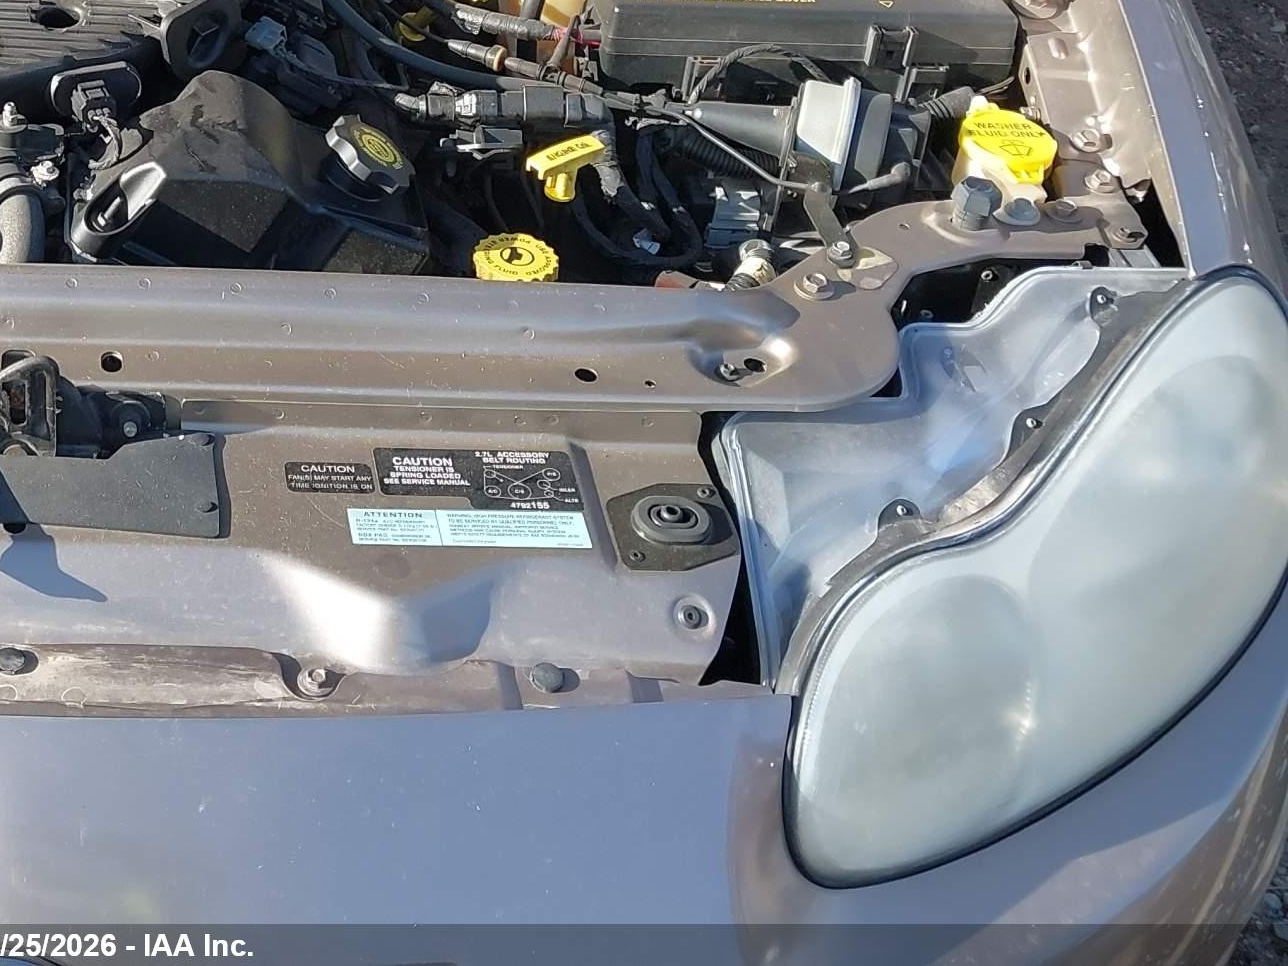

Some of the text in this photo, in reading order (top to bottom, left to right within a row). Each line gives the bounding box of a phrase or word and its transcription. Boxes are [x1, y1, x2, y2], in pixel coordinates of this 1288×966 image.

[974, 122, 1032, 130] WASHER
[968, 130, 1046, 138] FLUID ONLY
[496, 451, 550, 459] ACCESSORY
[392, 456, 453, 467] CAUTION
[300, 464, 355, 473] CAUTION
[393, 465, 444, 473] TENSIONER
[425, 472, 461, 480] LOADED
